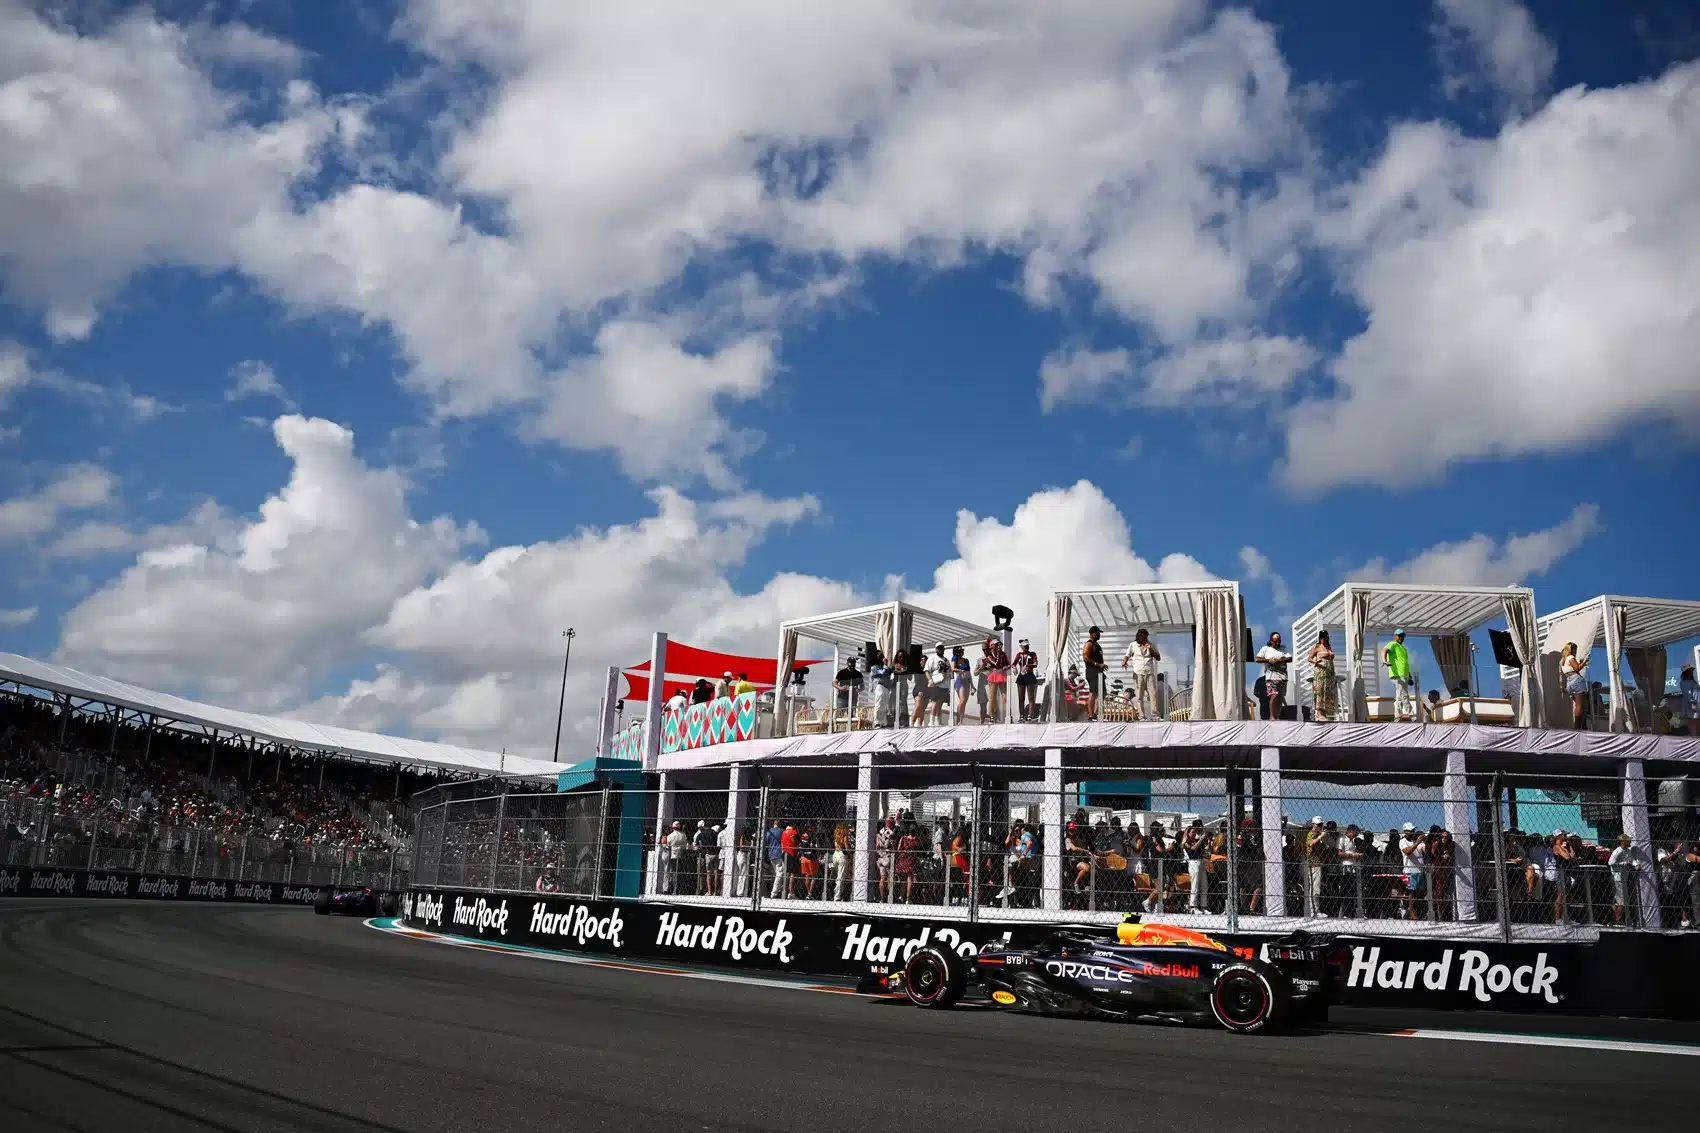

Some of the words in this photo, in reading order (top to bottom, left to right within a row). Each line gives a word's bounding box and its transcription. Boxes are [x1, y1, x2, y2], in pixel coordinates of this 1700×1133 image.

[31, 872, 55, 889] Hard
[54, 873, 75, 894] Rock
[86, 875, 110, 891] Hard
[108, 876, 129, 895] Rock
[138, 877, 161, 893] Hard
[159, 879, 179, 897] Rock
[188, 880, 210, 895] Hard
[209, 881, 227, 899] Rock
[233, 883, 254, 897] Hard
[253, 884, 272, 900] Rock
[282, 886, 304, 900] Hard
[426, 894, 444, 926] Rock
[453, 896, 479, 926] Hard
[476, 898, 509, 935] Rock
[530, 902, 575, 936] Hard
[573, 905, 624, 948] Rock
[656, 911, 723, 951] Hard
[722, 916, 793, 964] Rock
[842, 923, 931, 965] Hard
[1270, 948, 1304, 960] Mobil
[871, 965, 889, 974] Mobil
[1045, 961, 1133, 983] ORACLE
[1143, 961, 1170, 976] Red
[1172, 964, 1199, 979] Bull
[1347, 946, 1454, 990] Hard
[1459, 949, 1559, 1004] Rock
